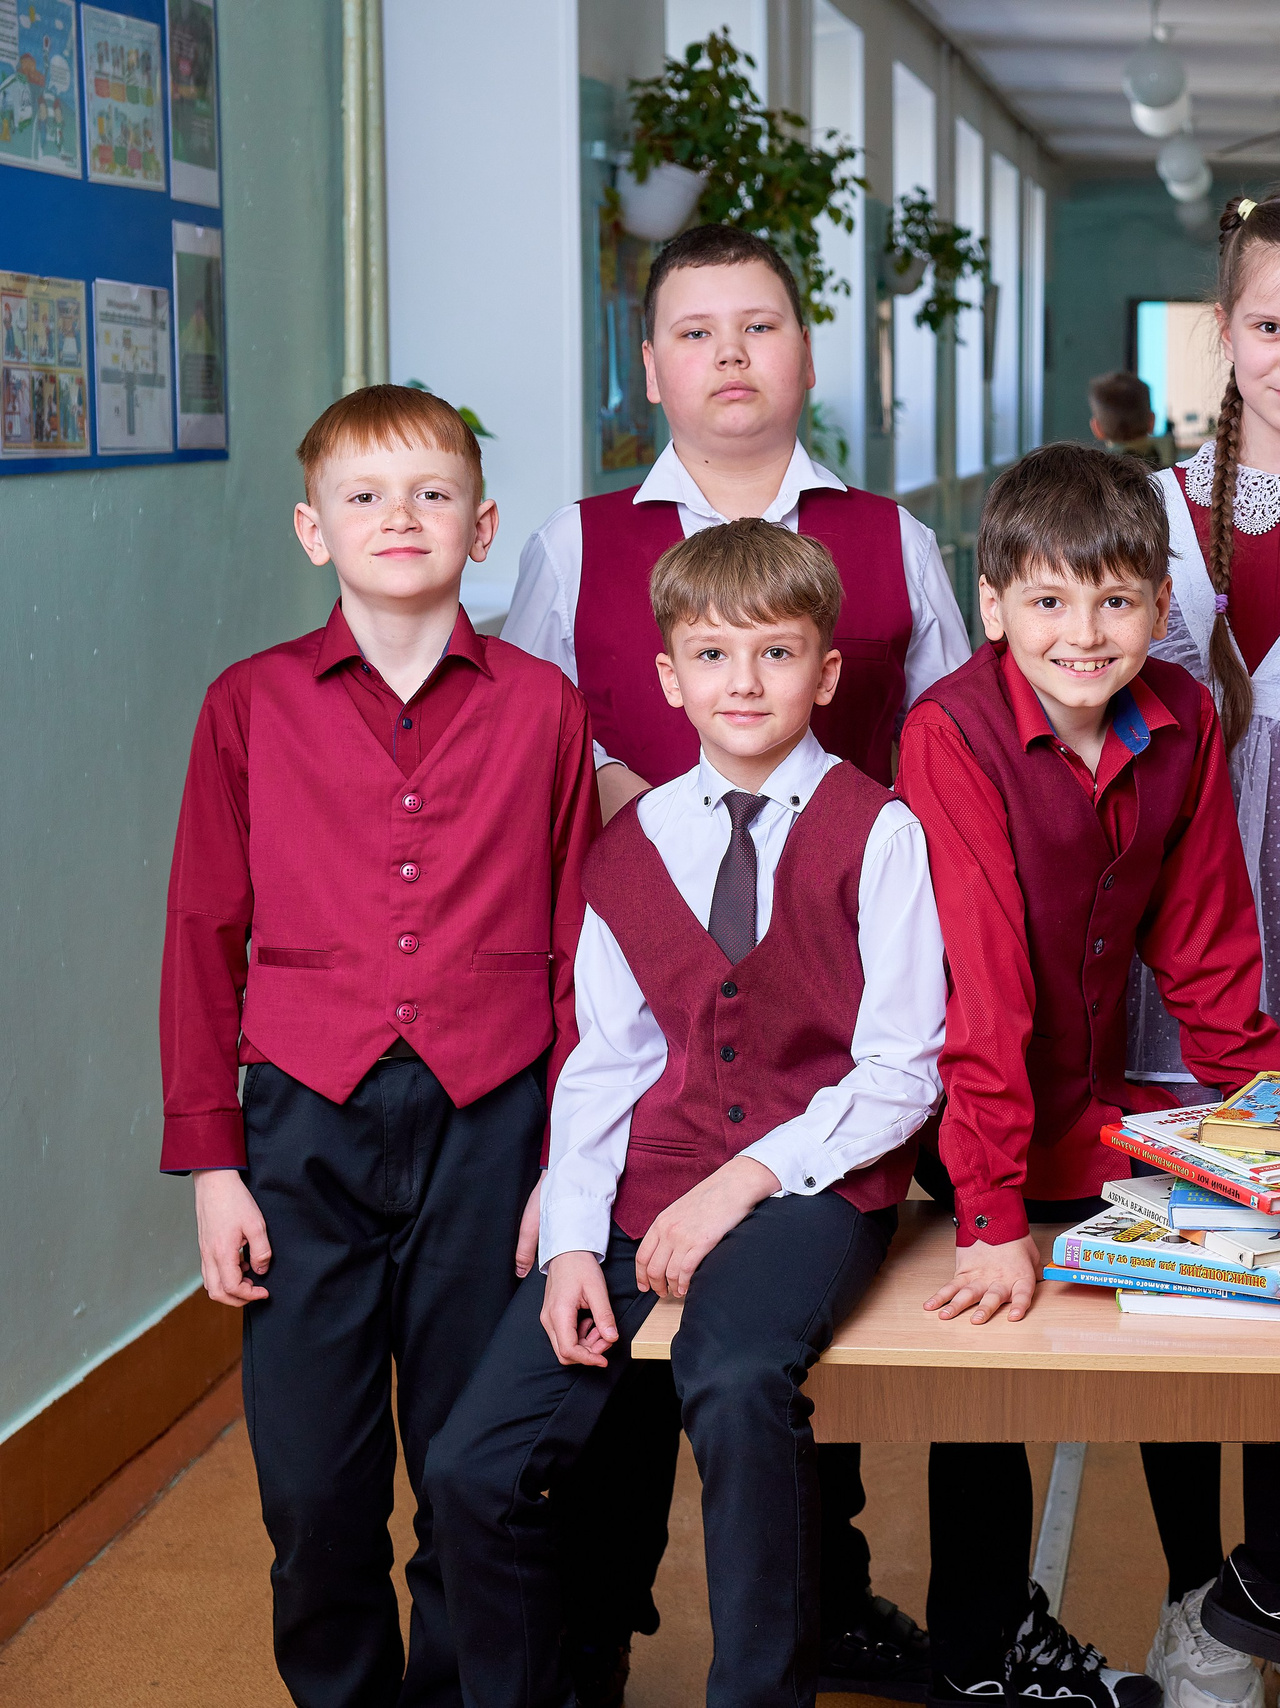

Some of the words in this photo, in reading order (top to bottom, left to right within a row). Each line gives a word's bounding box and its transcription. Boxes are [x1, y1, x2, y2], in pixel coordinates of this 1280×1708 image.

[1111, 1136, 1141, 1155] ГЛАЗАМИ
[1142, 1151, 1190, 1176] ОРАНЖЕВЫМИ
[1197, 1174, 1210, 1187] КОТ
[1211, 1180, 1240, 1199] ЧЕРНЫЙ
[1107, 1191, 1129, 1208] АЗБУКА
[1083, 1249, 1092, 1262] Я
[1093, 1250, 1105, 1260] до
[1107, 1252, 1116, 1266] А
[1117, 1254, 1128, 1264] от
[1130, 1256, 1156, 1268] детей
[1158, 1260, 1176, 1272] для
[1080, 1274, 1134, 1286] чемоданчика
[1179, 1263, 1267, 1289] ЭНЦИКЛОПЕДИЯ
[1136, 1281, 1170, 1290] жёлтого
[1173, 1284, 1228, 1298] Приключения
